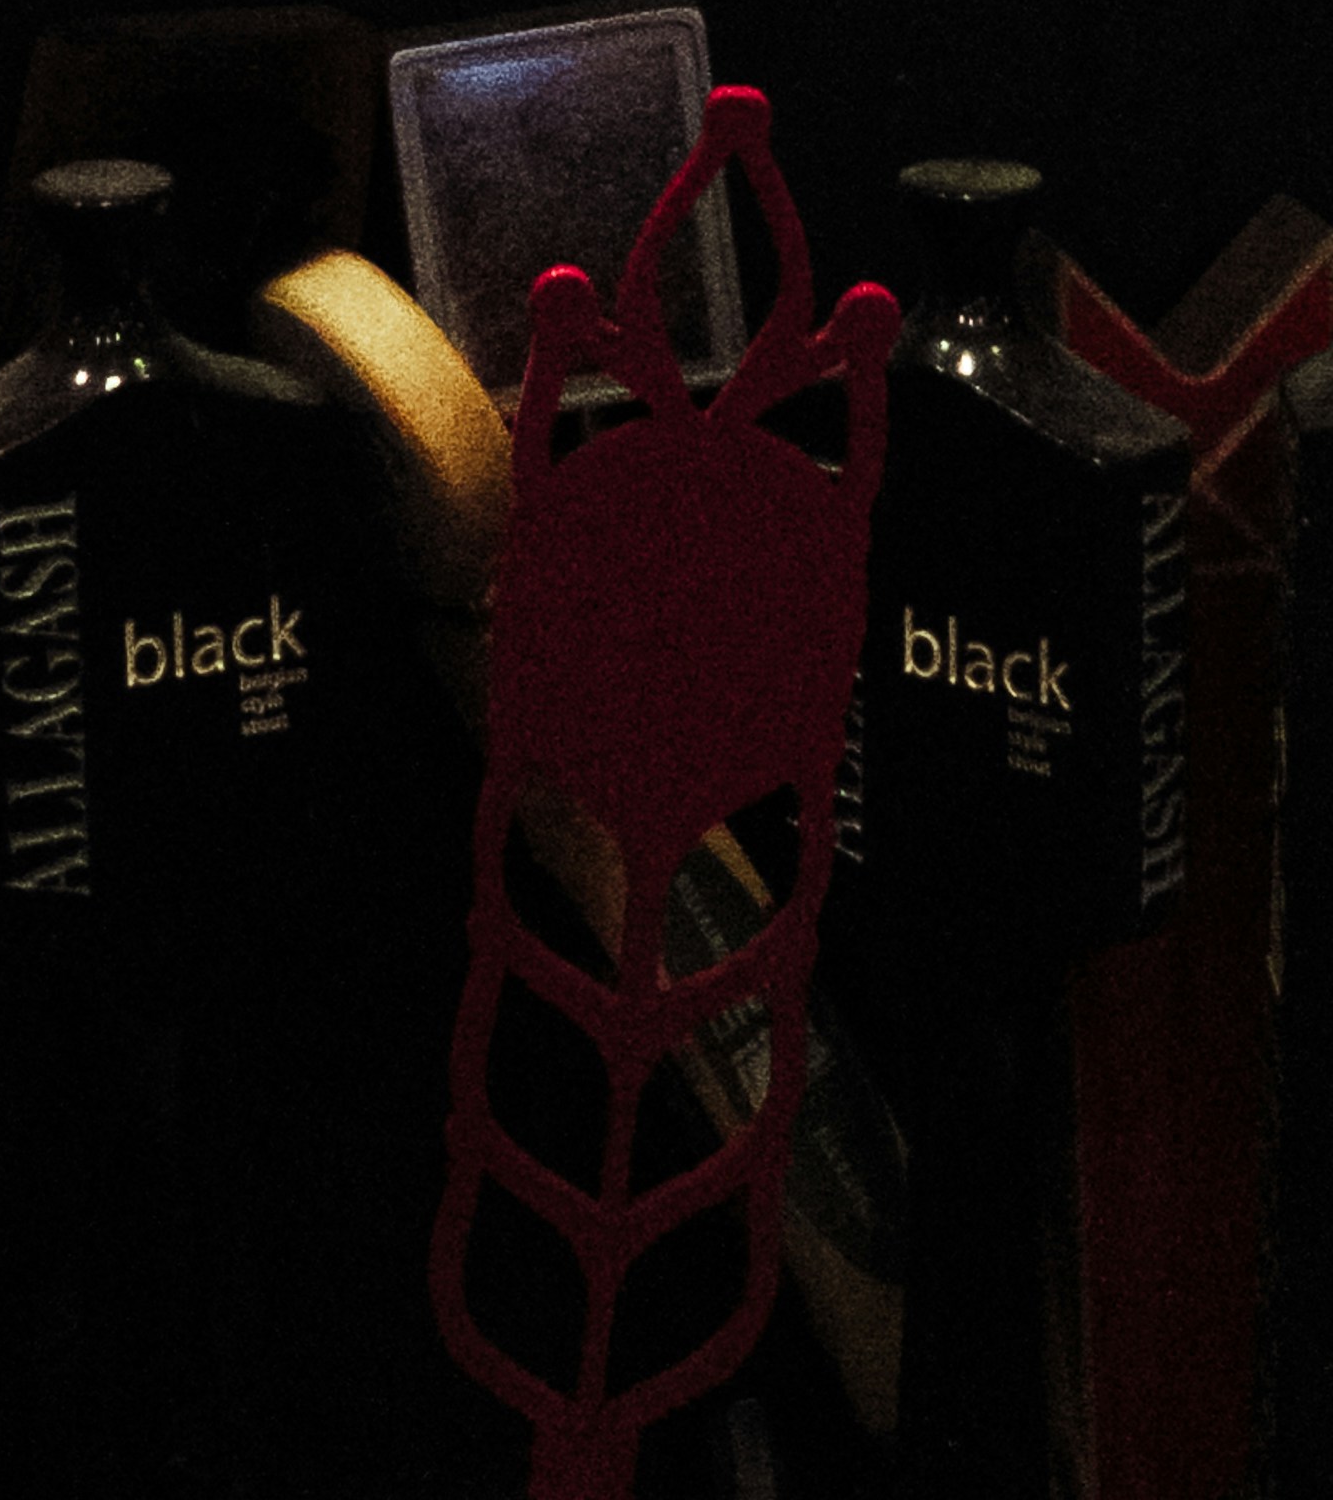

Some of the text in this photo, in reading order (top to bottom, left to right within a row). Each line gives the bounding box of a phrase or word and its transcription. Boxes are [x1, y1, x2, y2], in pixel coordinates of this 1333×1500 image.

[123, 593, 309, 690] black
[901, 604, 1074, 713] black
[1140, 493, 1187, 908] ALLAGASH
